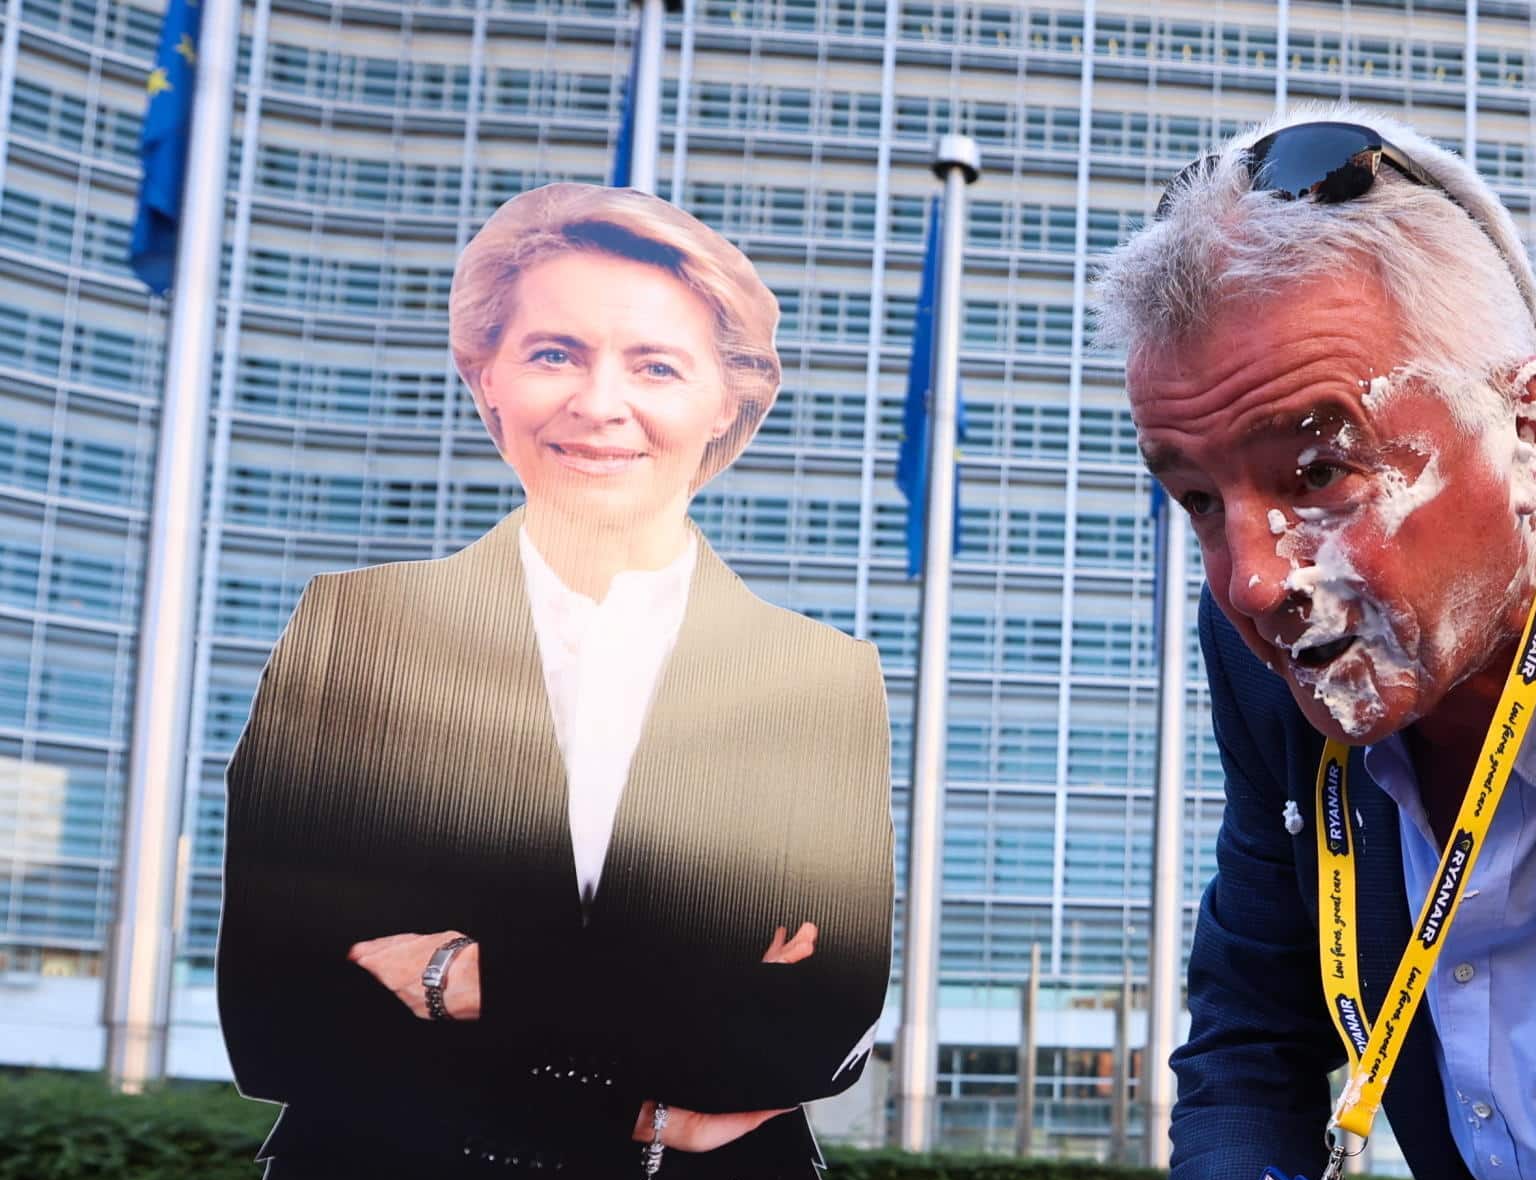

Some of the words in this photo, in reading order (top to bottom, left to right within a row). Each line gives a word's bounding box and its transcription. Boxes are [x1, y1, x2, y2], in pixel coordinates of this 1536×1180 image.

[1508, 701, 1524, 725] Low
[1483, 753, 1499, 794] great
[1328, 765, 1342, 840] RYANAIR
[1474, 791, 1486, 817] care
[1333, 869, 1342, 893] care
[1422, 850, 1466, 942] RYANAIR
[1329, 893, 1346, 928] great
[1331, 959, 1345, 979] Low
[1406, 966, 1422, 990] Low
[1378, 1020, 1395, 1060] great
[1368, 1058, 1381, 1084] care
